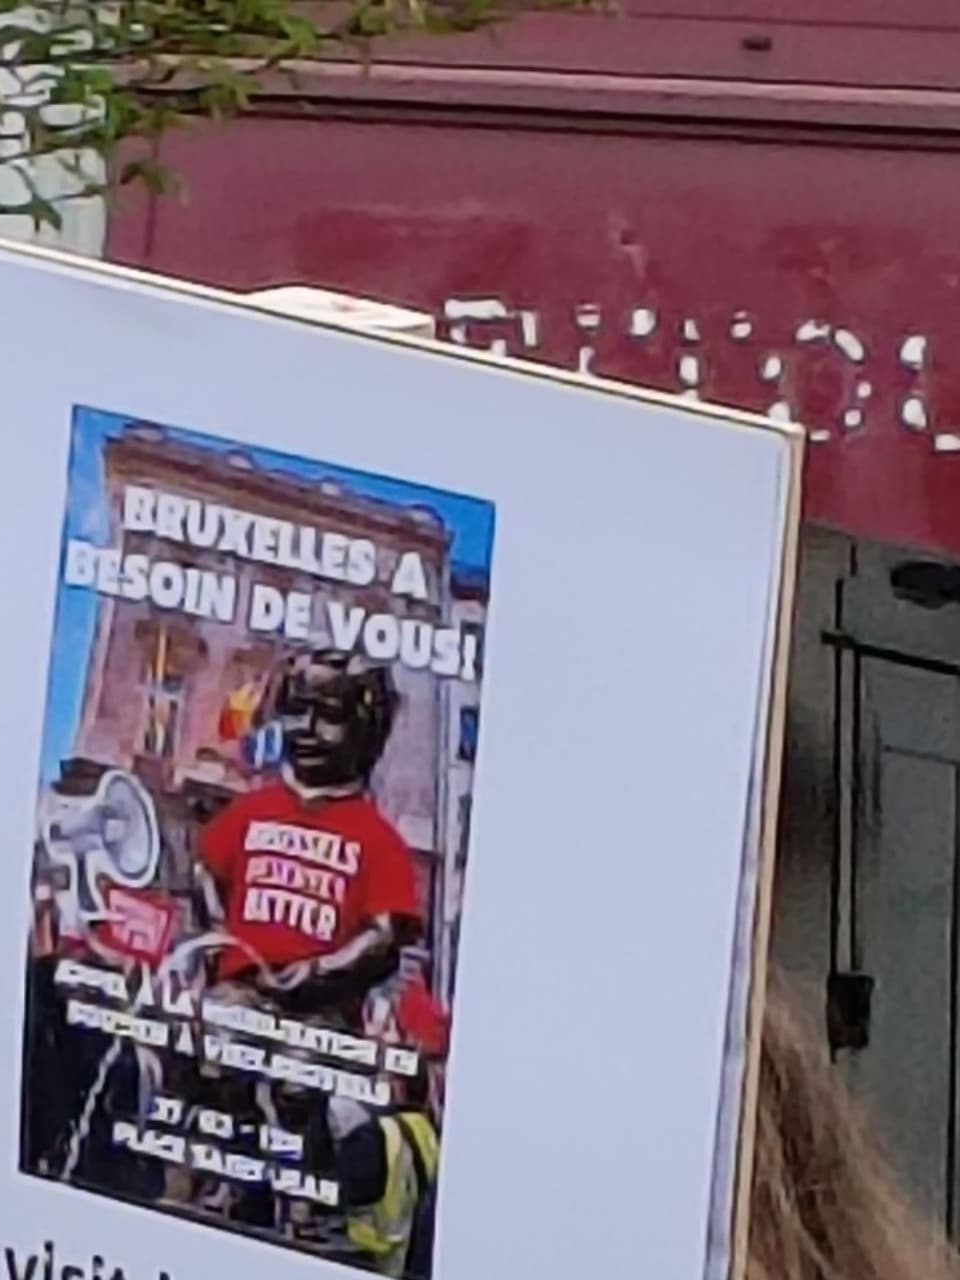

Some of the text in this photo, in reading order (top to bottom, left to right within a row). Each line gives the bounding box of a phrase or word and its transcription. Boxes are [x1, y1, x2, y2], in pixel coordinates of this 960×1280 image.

[123, 486, 376, 587] BRUXELLES
[64, 539, 477, 682] BESOIN DE VOUS!
